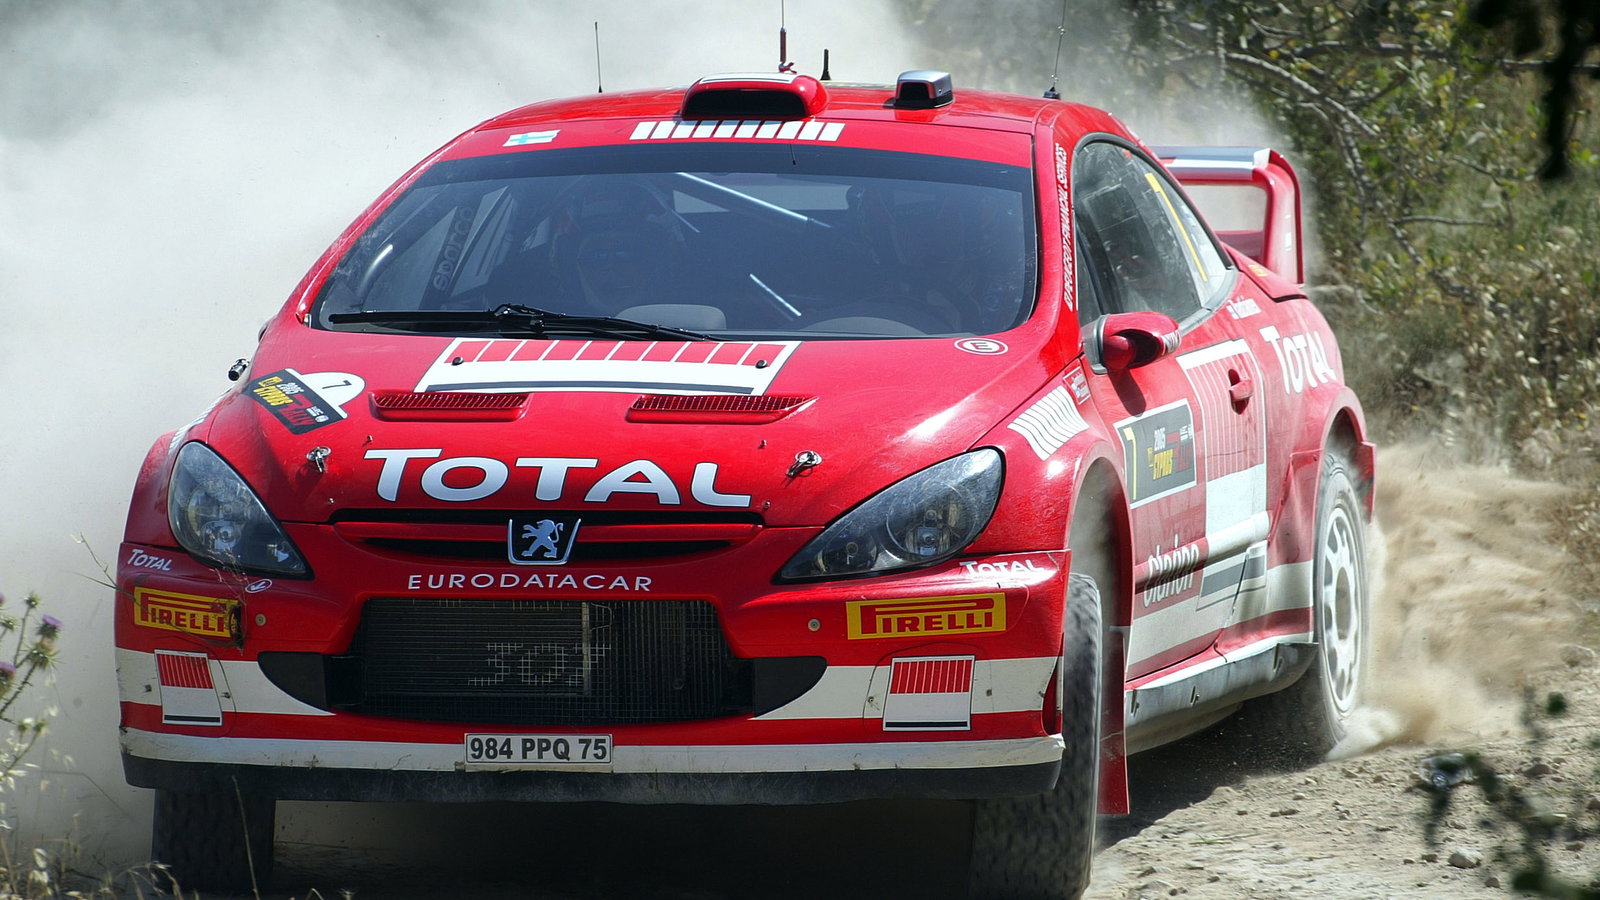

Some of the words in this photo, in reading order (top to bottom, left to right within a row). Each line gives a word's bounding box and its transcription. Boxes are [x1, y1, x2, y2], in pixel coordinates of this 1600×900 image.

[1259, 325, 1337, 395] TOTAL
[364, 448, 752, 507] TOTAL
[1123, 427, 1137, 500] 7
[127, 549, 172, 571] TOTAL
[960, 559, 1045, 578] TOTAL
[408, 573, 652, 592] EURODATACAR
[141, 592, 227, 633] PIRELLI
[860, 598, 995, 635] PIRELLI
[470, 738, 513, 760] 984
[521, 738, 570, 761] PPQ
[578, 738, 607, 760] 75
